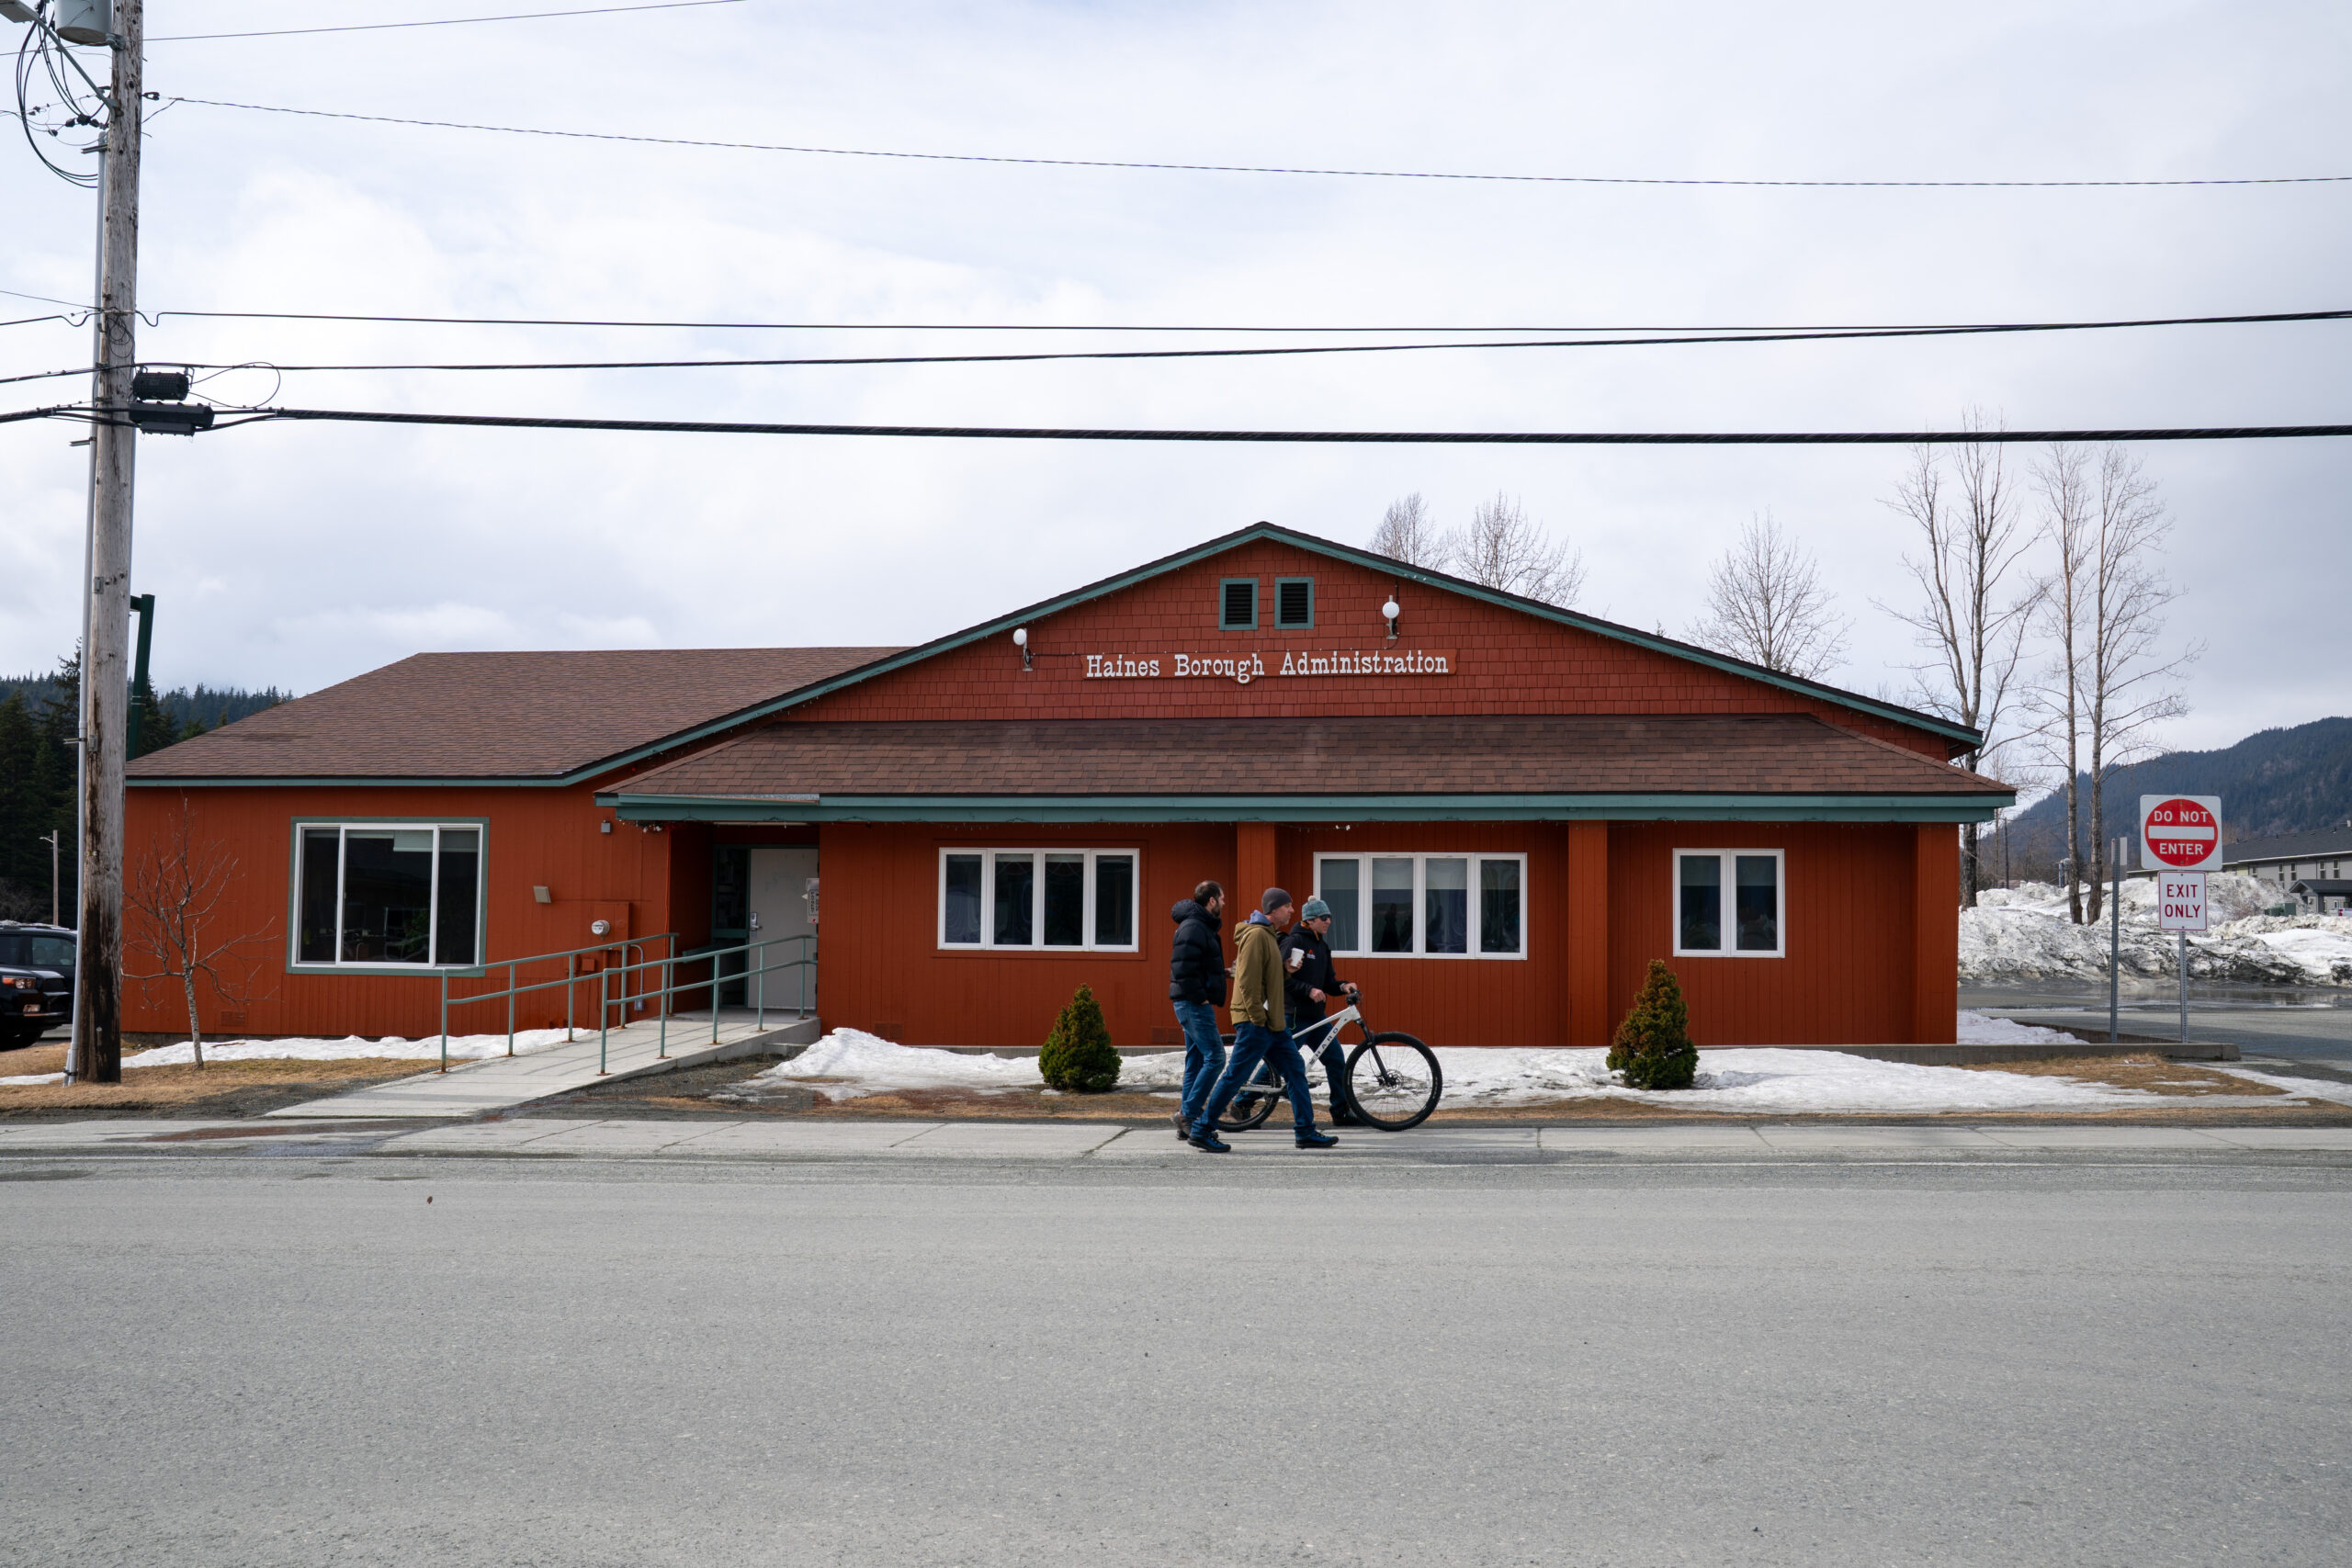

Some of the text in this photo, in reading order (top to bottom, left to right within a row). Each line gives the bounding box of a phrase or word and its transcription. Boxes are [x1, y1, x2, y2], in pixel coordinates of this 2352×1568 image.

[1086, 649, 1449, 684] Haines Borough Administration
[2154, 810, 2209, 823] DO NOT
[2159, 842, 2204, 855] ENTER
[2166, 884, 2198, 898] EXIT
[2165, 904, 2201, 919] ONLY
